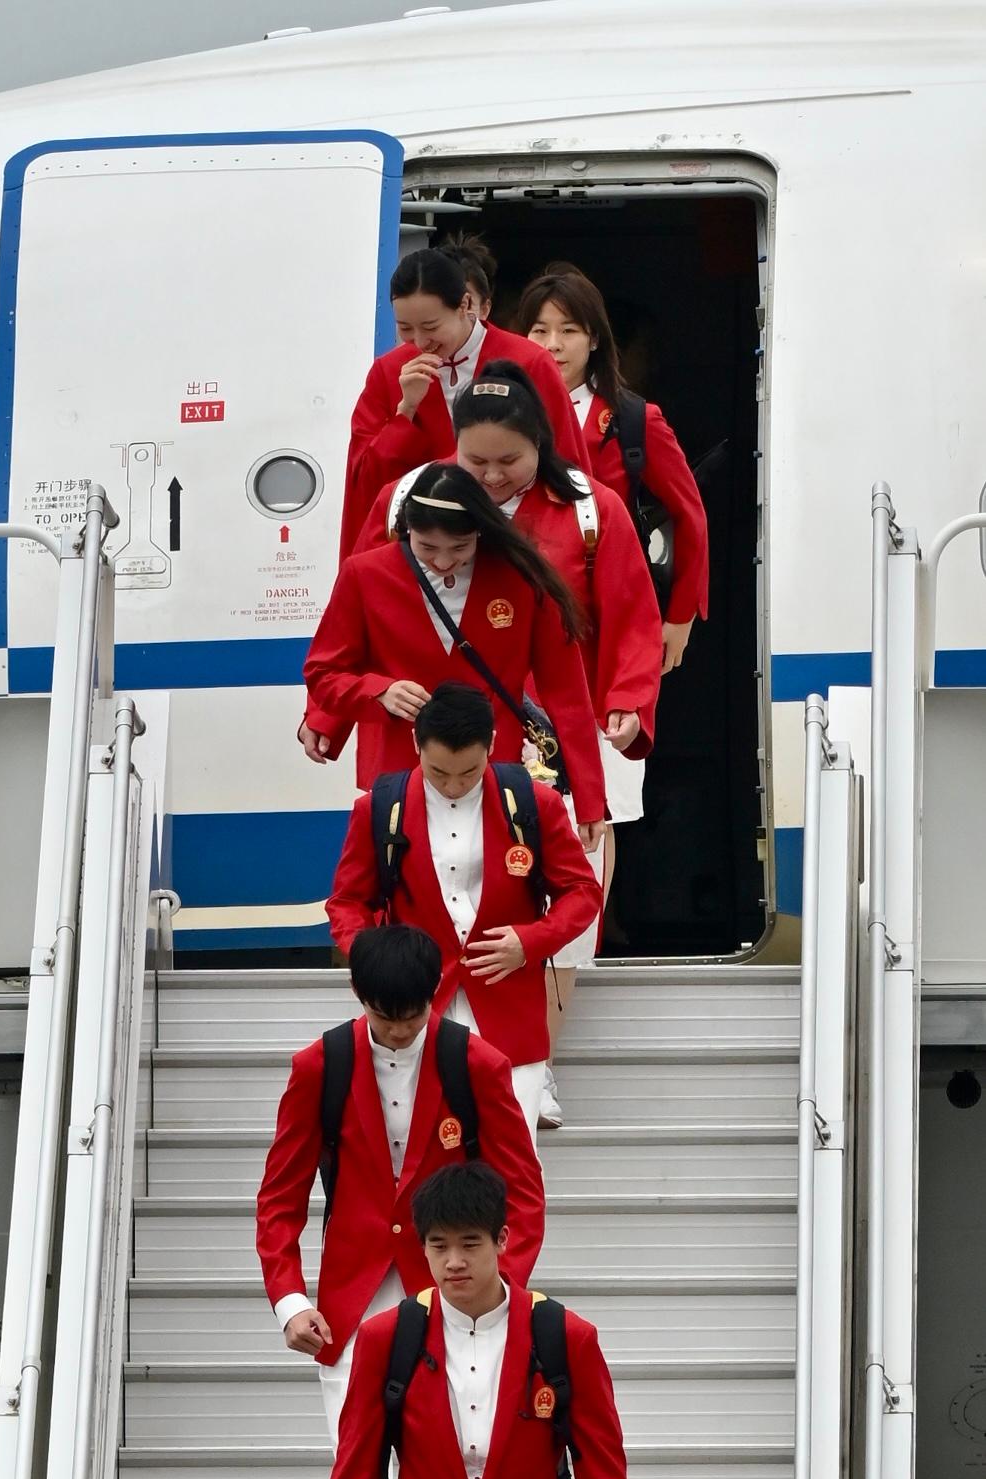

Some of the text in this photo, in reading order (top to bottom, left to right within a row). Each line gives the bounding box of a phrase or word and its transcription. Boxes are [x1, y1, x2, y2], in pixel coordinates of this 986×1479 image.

[187, 381, 218, 394] 出口
[185, 406, 220, 418] EXIT
[35, 479, 91, 493] 开门步骤
[35, 512, 87, 525] TO OPE
[276, 552, 297, 561] 危险
[266, 588, 309, 598] DANGER
